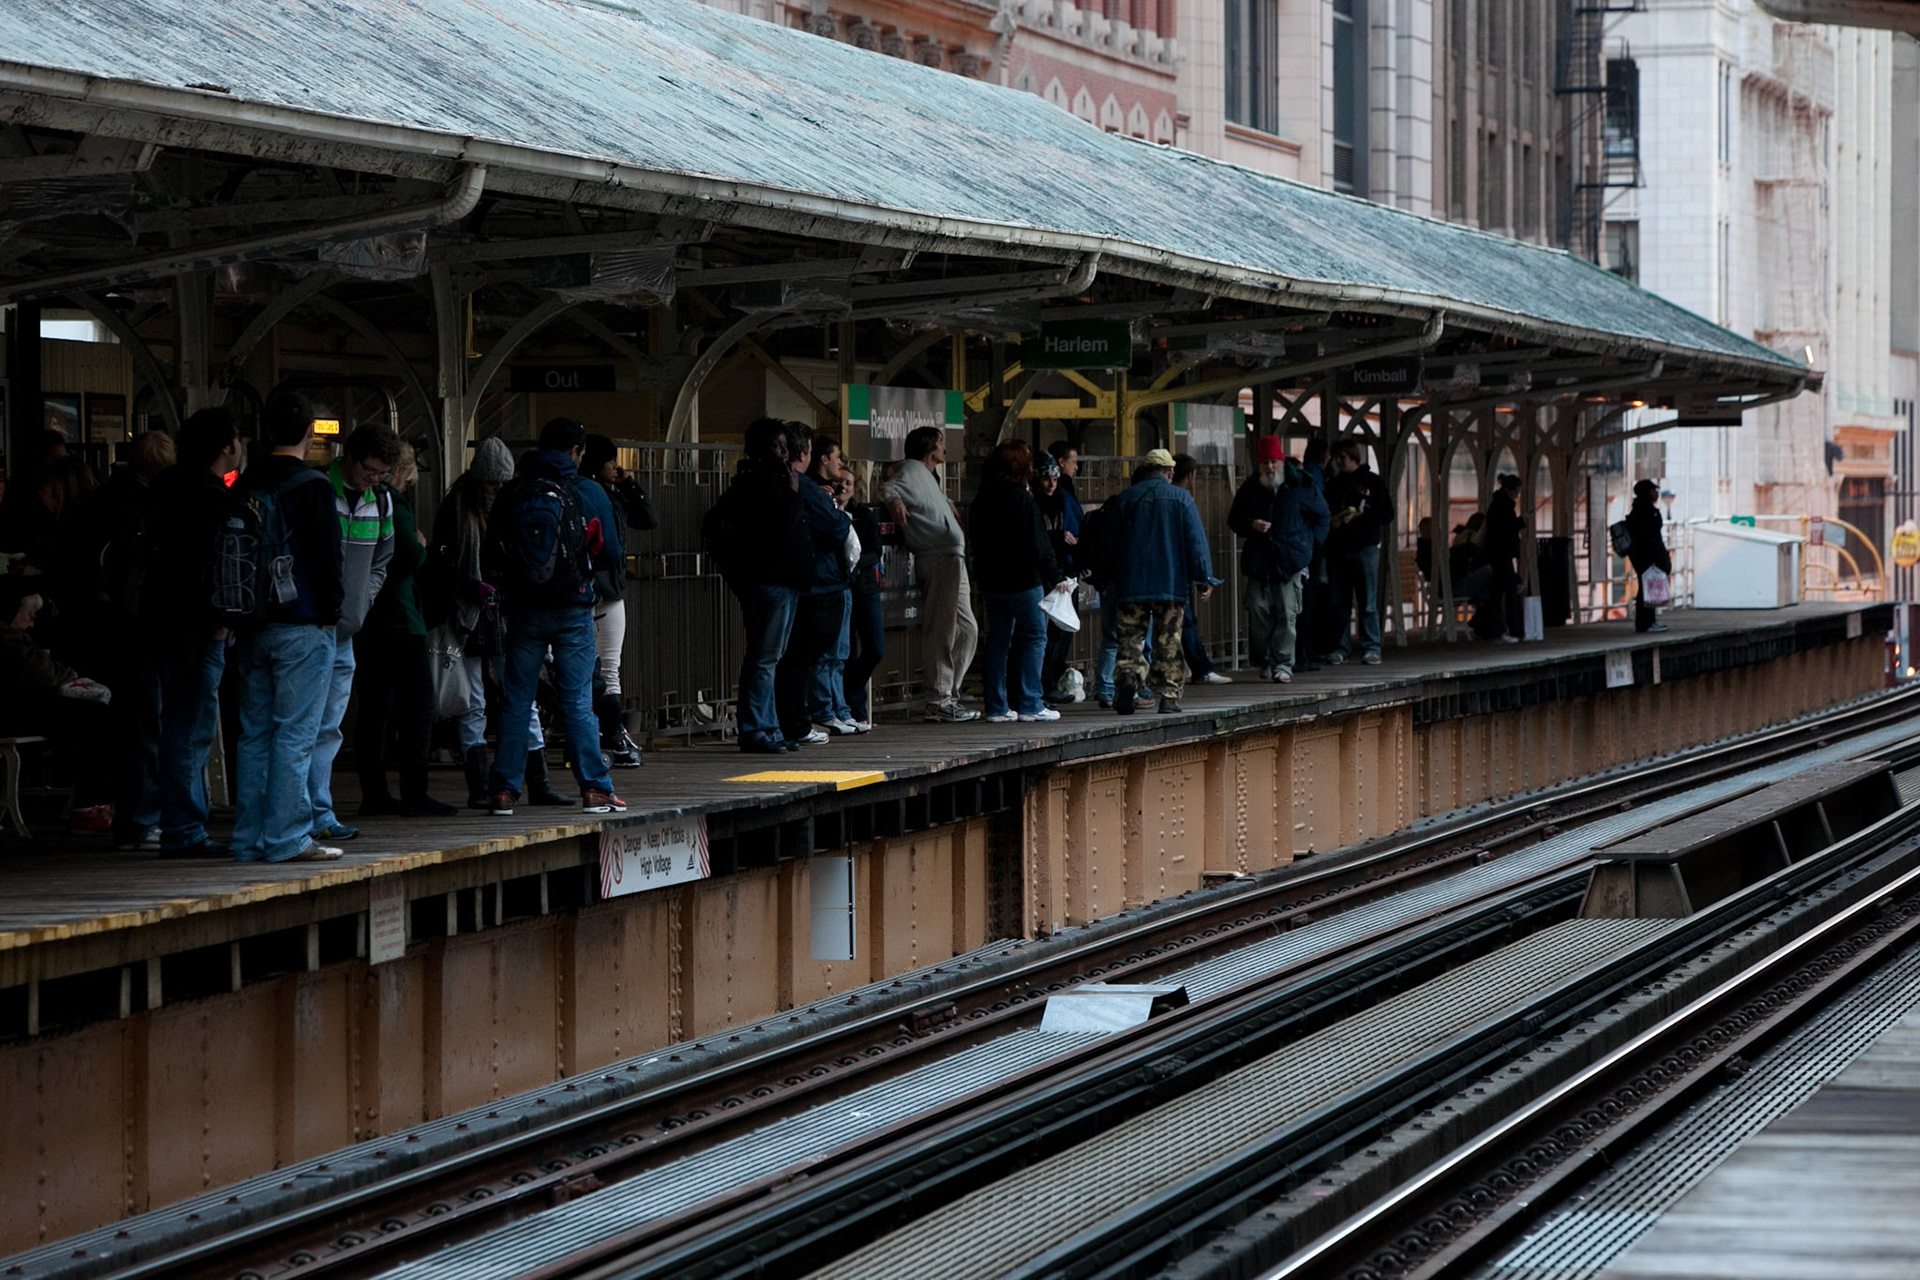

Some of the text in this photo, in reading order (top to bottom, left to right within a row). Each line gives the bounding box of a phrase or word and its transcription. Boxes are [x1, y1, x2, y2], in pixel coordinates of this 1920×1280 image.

[1044, 335, 1109, 353] Harlem
[544, 370, 581, 389] Out
[1353, 367, 1407, 383] Kimball
[623, 834, 642, 857] Danger
[647, 831, 661, 852] Keep
[661, 828, 669, 845] Off
[669, 826, 685, 845] Tracks
[640, 854, 672, 880] High Voltage
